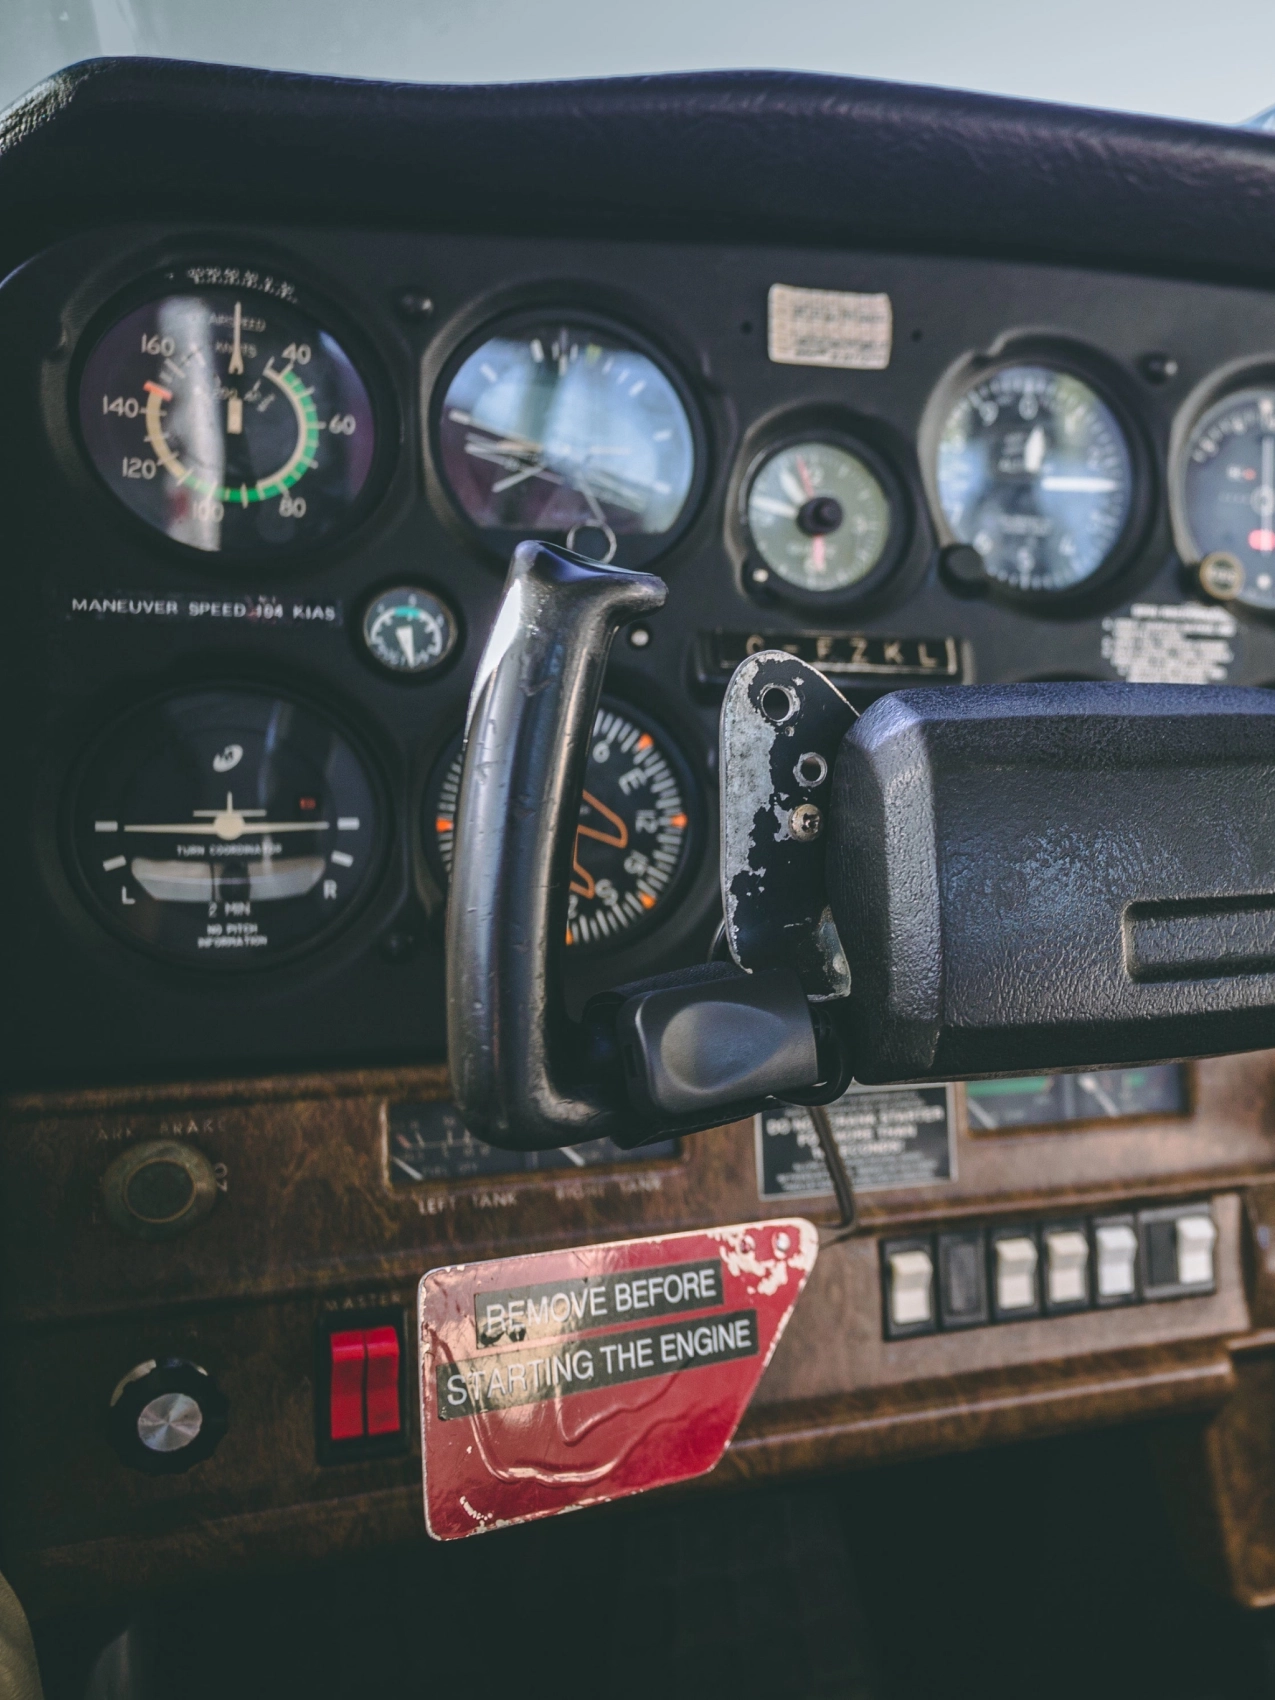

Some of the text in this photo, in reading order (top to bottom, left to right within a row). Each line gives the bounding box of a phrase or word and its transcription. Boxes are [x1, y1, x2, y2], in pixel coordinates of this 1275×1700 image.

[141, 333, 175, 356] 160
[281, 341, 312, 365] 40
[103, 394, 138, 418] 140
[328, 414, 356, 435] 60
[122, 456, 157, 479] 120
[192, 501, 225, 522] 100
[278, 497, 308, 519] 80
[72, 598, 178, 615] MANEUVER
[189, 601, 246, 617] SPEED
[292, 604, 336, 621] KIAS
[618, 767, 647, 796] E
[177, 843, 206, 858] TURN
[121, 884, 136, 905] L
[323, 879, 338, 900] R
[594, 877, 619, 907] S
[208, 900, 251, 919] 2 MIN
[417, 1190, 518, 1216] LEFT TANK
[324, 1290, 402, 1311] MASTER
[485, 1268, 717, 1333] REMOVE BEFORE
[446, 1318, 752, 1406] STARTING THE ENGINE
